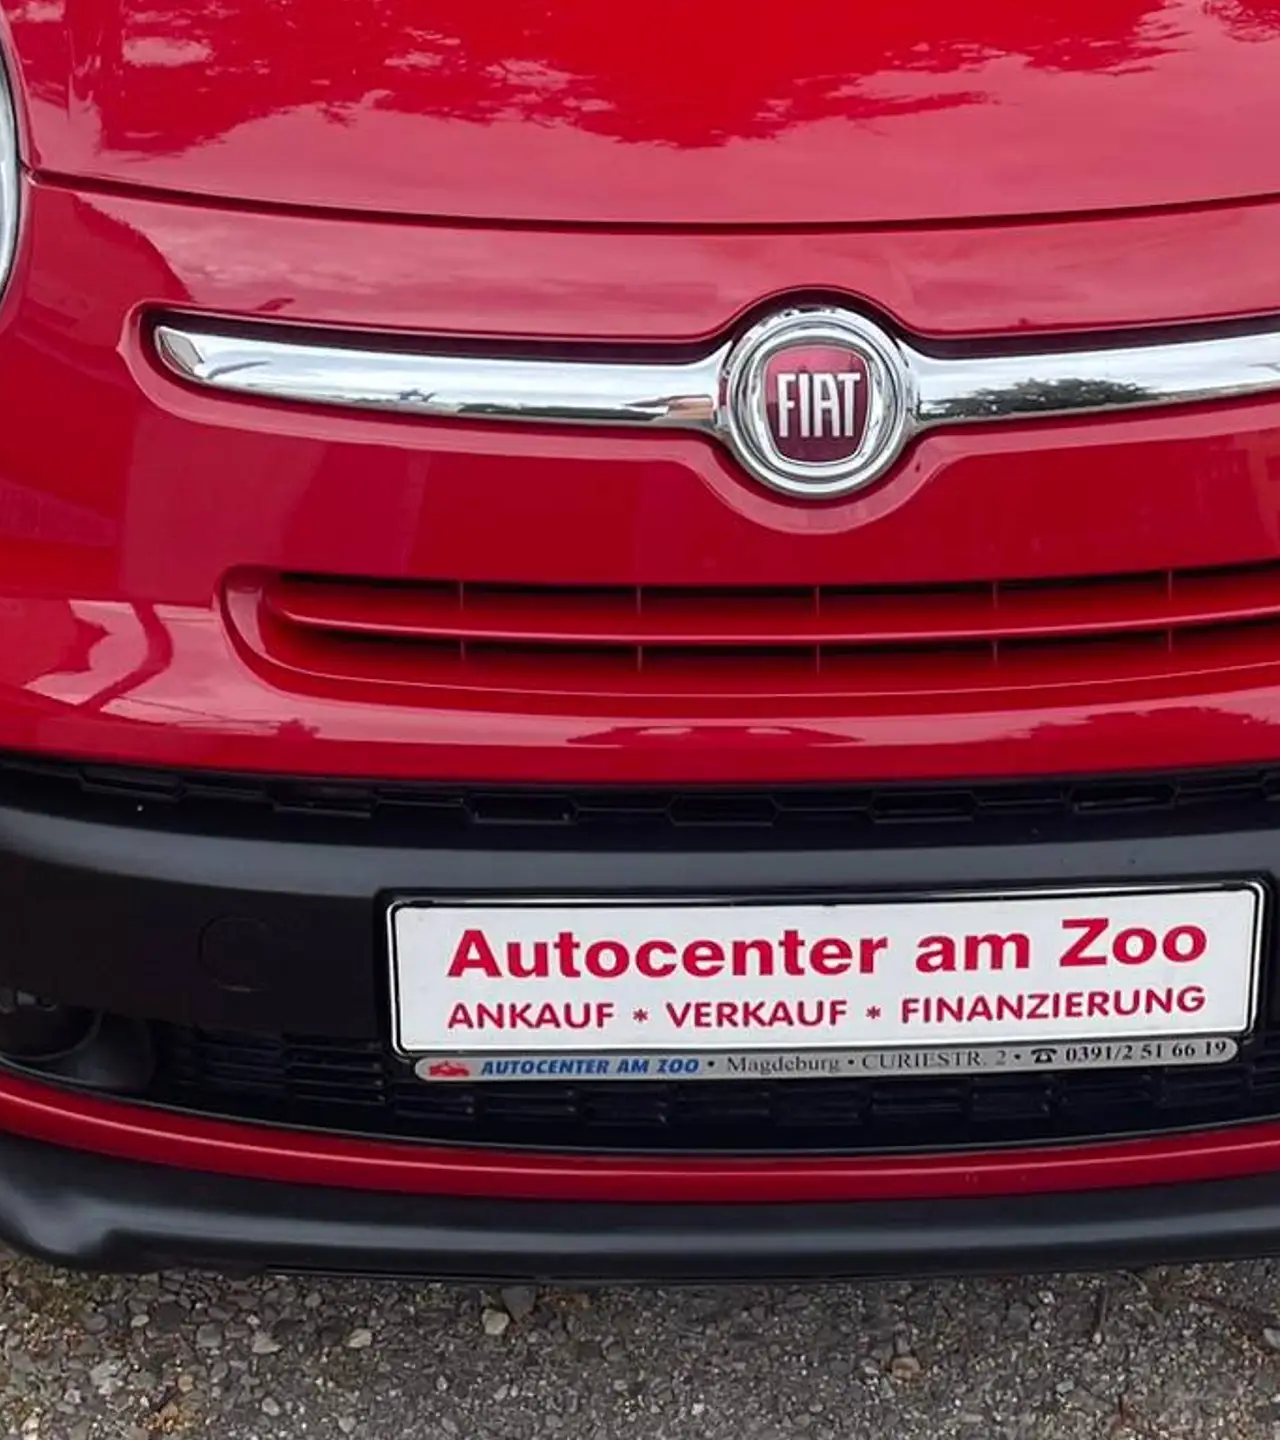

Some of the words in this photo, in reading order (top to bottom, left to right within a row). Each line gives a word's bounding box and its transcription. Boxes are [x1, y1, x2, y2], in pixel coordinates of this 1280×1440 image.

[776, 371, 862, 438] FIAT
[447, 929, 888, 978] Autocenter
[915, 933, 1030, 972] am
[1059, 917, 1208, 968] Zoo
[447, 1002, 615, 1029] ANKAUF
[666, 999, 848, 1028] VERKAUF
[901, 985, 1207, 1024] FINANZIERUNG
[480, 1060, 610, 1076] AUTOCENTER
[616, 1059, 650, 1075] AM
[656, 1058, 701, 1074] ZOO
[726, 1056, 840, 1076] Magdeburg
[862, 1050, 987, 1069] CURIESTR.
[996, 1050, 1007, 1066] 2
[1065, 1044, 1134, 1062] 0391/2
[1140, 1043, 1162, 1060] 51
[1171, 1042, 1196, 1058] 66
[1205, 1040, 1227, 1057] 19
